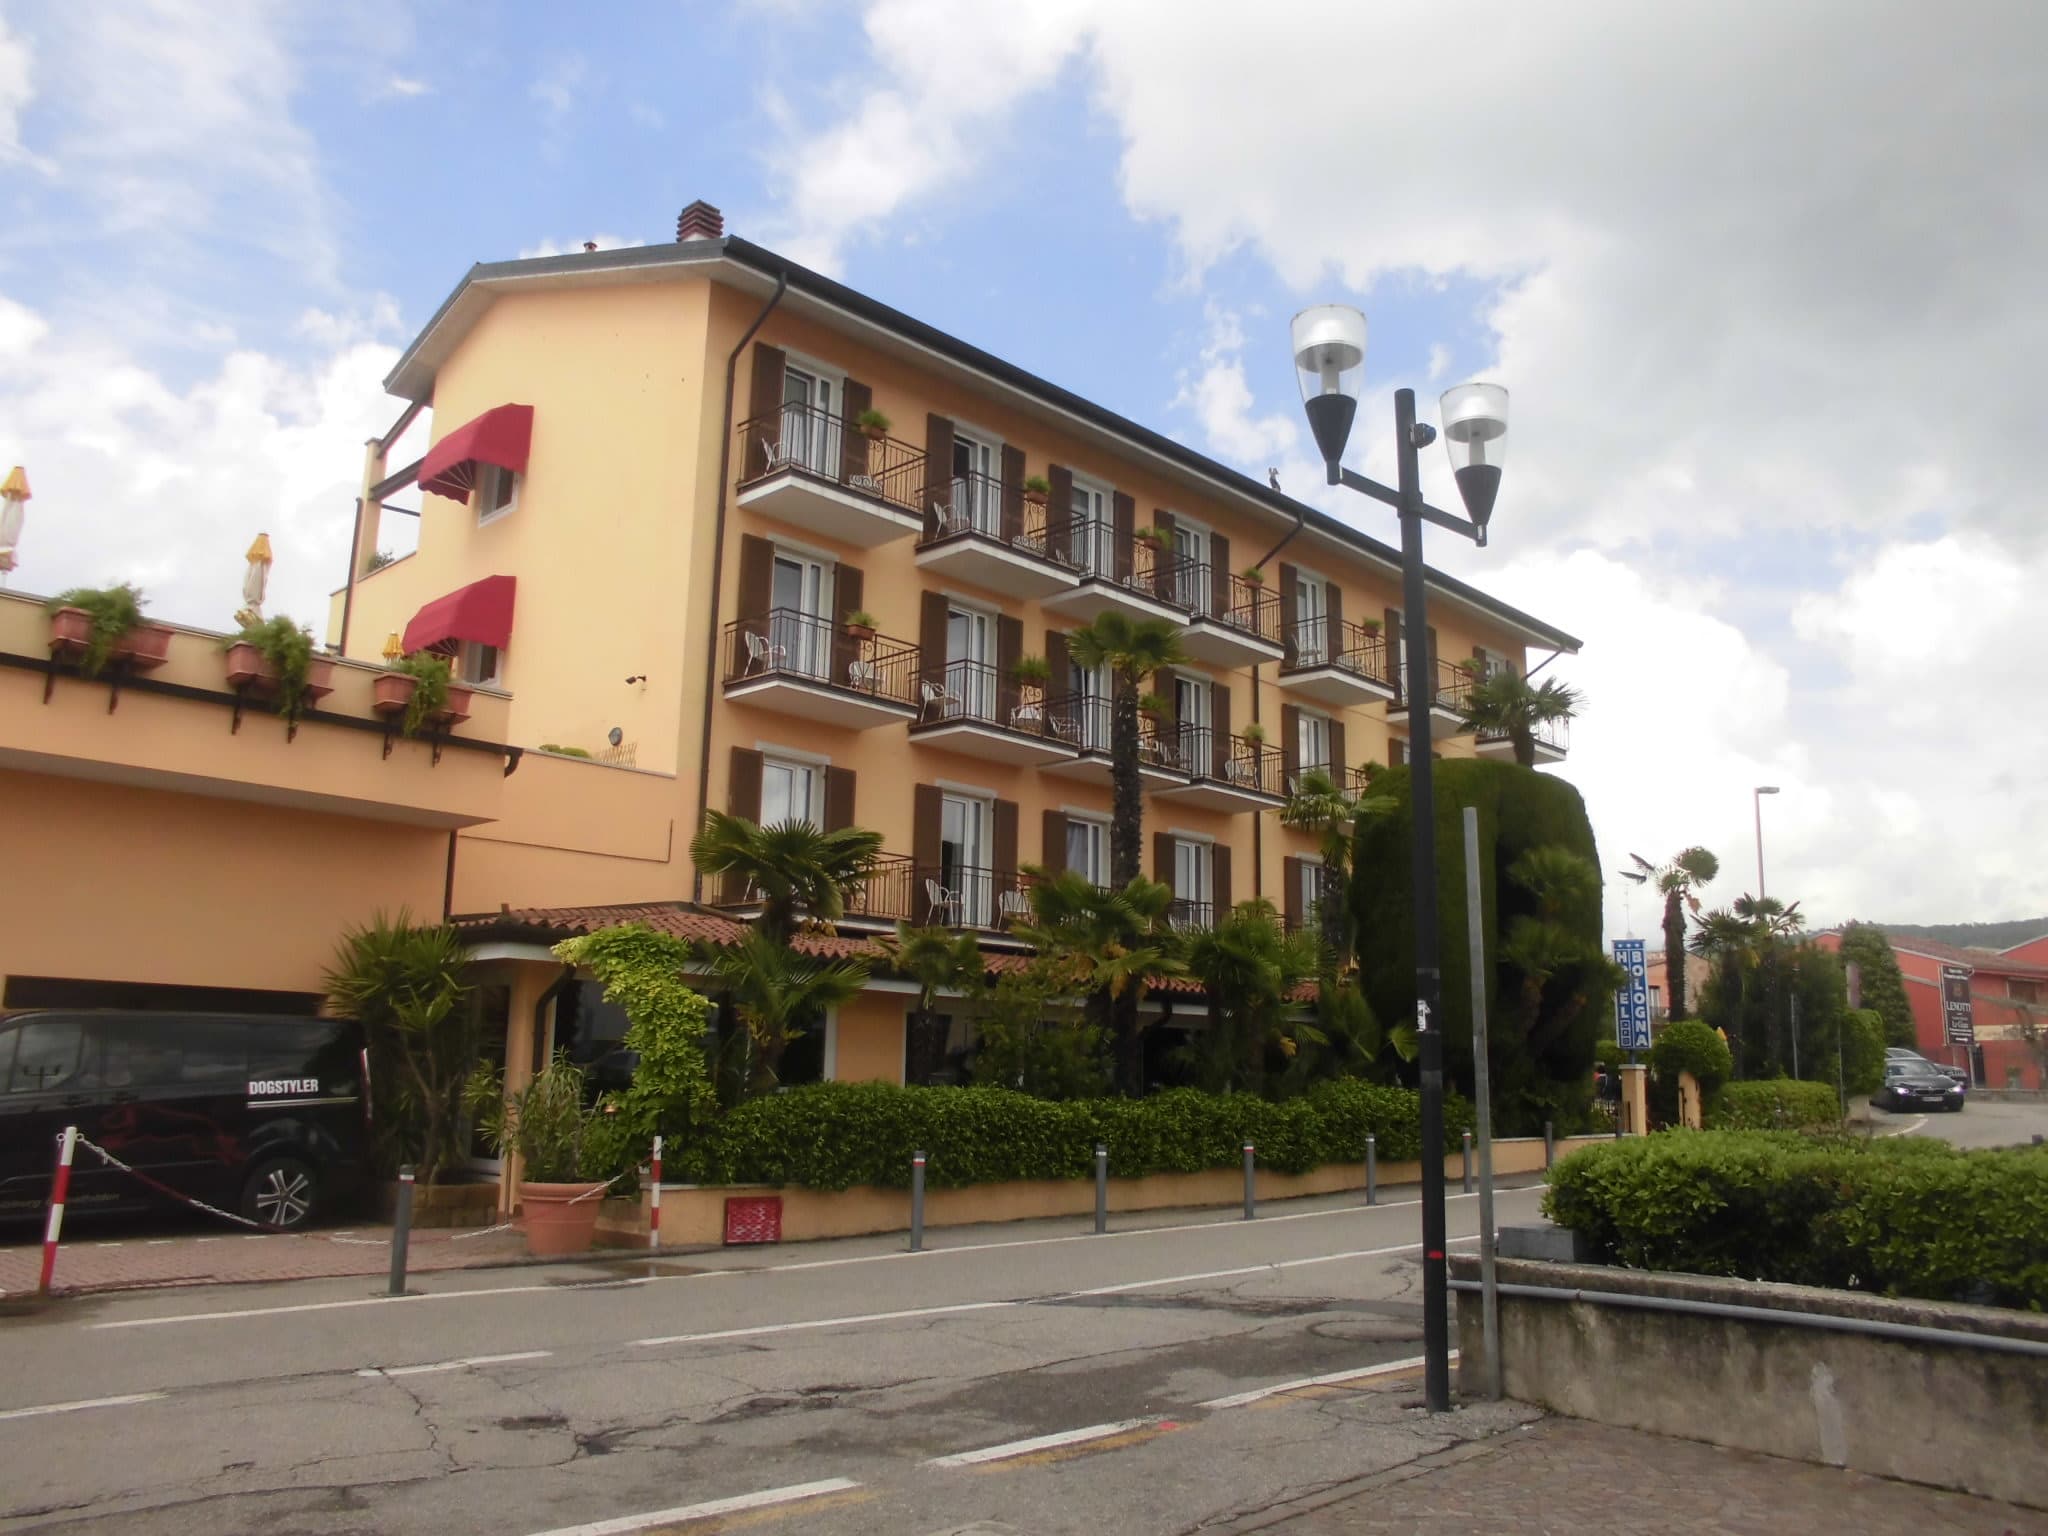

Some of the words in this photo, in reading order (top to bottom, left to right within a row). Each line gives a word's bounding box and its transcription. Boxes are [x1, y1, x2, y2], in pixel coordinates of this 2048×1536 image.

[1616, 951, 1629, 1019] HEL
[1631, 951, 1648, 1046] BOLOGNA
[248, 1079, 319, 1095] DOGSTYLER
